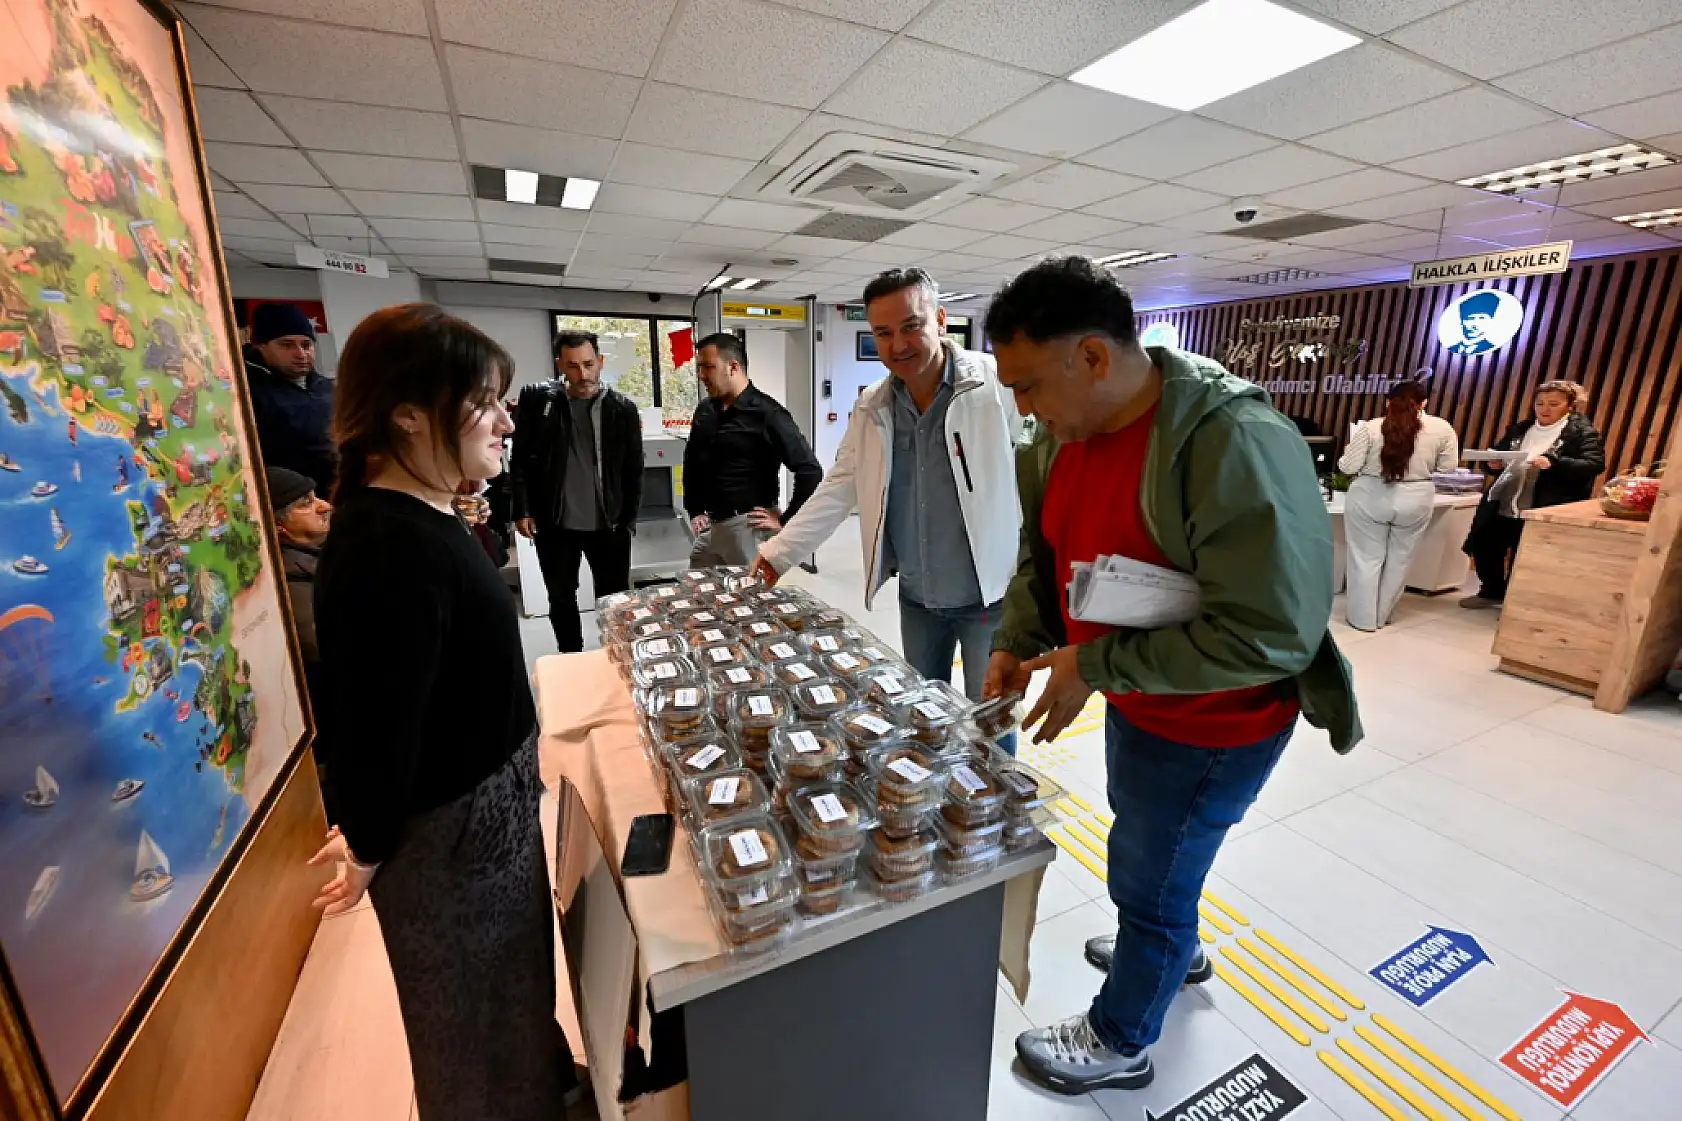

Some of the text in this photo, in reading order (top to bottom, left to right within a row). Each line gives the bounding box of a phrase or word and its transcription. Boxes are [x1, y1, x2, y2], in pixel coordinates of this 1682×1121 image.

[1416, 251, 1560, 281] HALKLA İLİŞKİLER
[1379, 932, 1454, 986] MÜDÜRLÜĞÜ
[1402, 946, 1473, 997] PLAN PROJE
[1516, 1005, 1593, 1075] MÜDÜRLÜĞÜ
[1539, 1020, 1625, 1094] YAPI KONTROL
